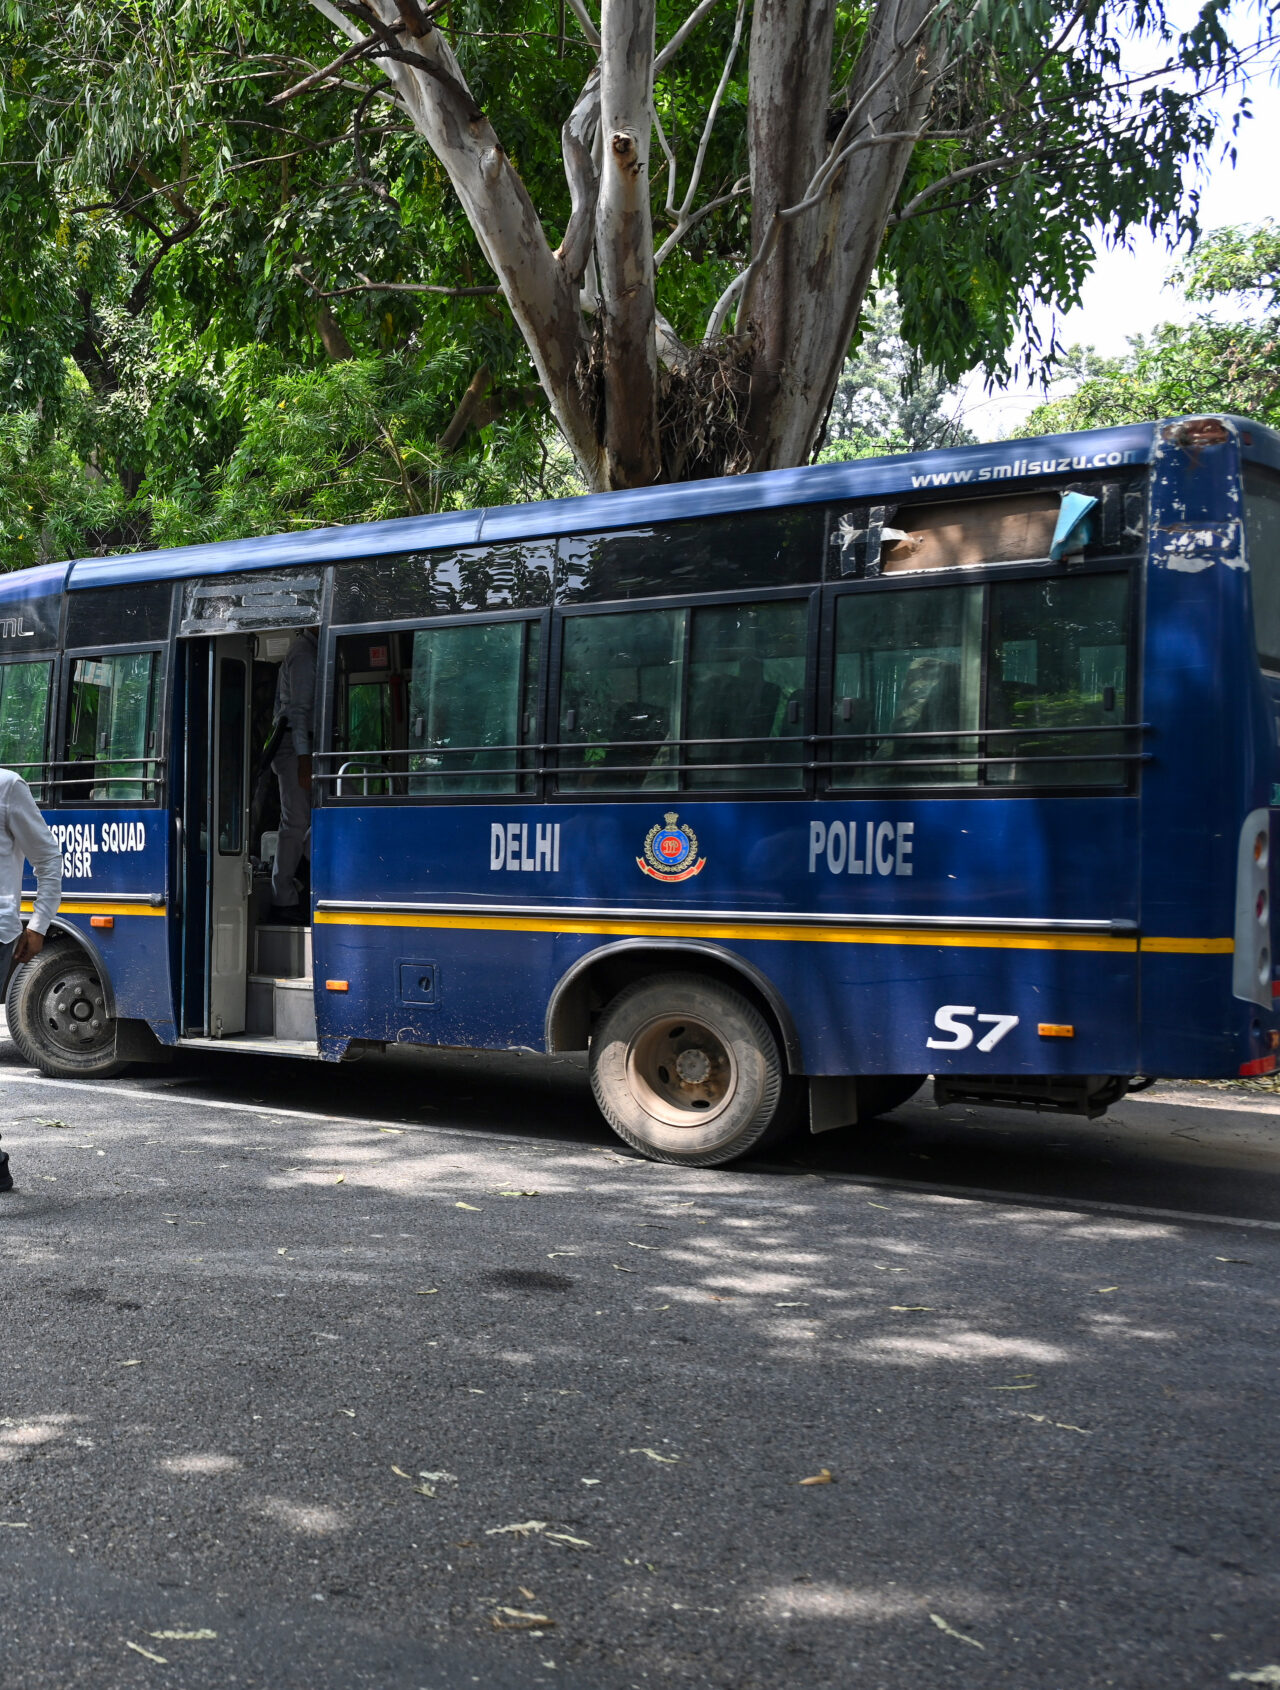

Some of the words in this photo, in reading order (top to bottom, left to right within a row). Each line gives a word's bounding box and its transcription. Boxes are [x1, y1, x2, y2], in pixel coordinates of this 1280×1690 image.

[48, 823, 99, 853] SPOSAL
[101, 821, 145, 854] SQUAD
[490, 823, 561, 872] DELHI
[808, 820, 914, 876] POLICE
[61, 851, 93, 878] S/SR
[926, 1005, 1020, 1053] S7
